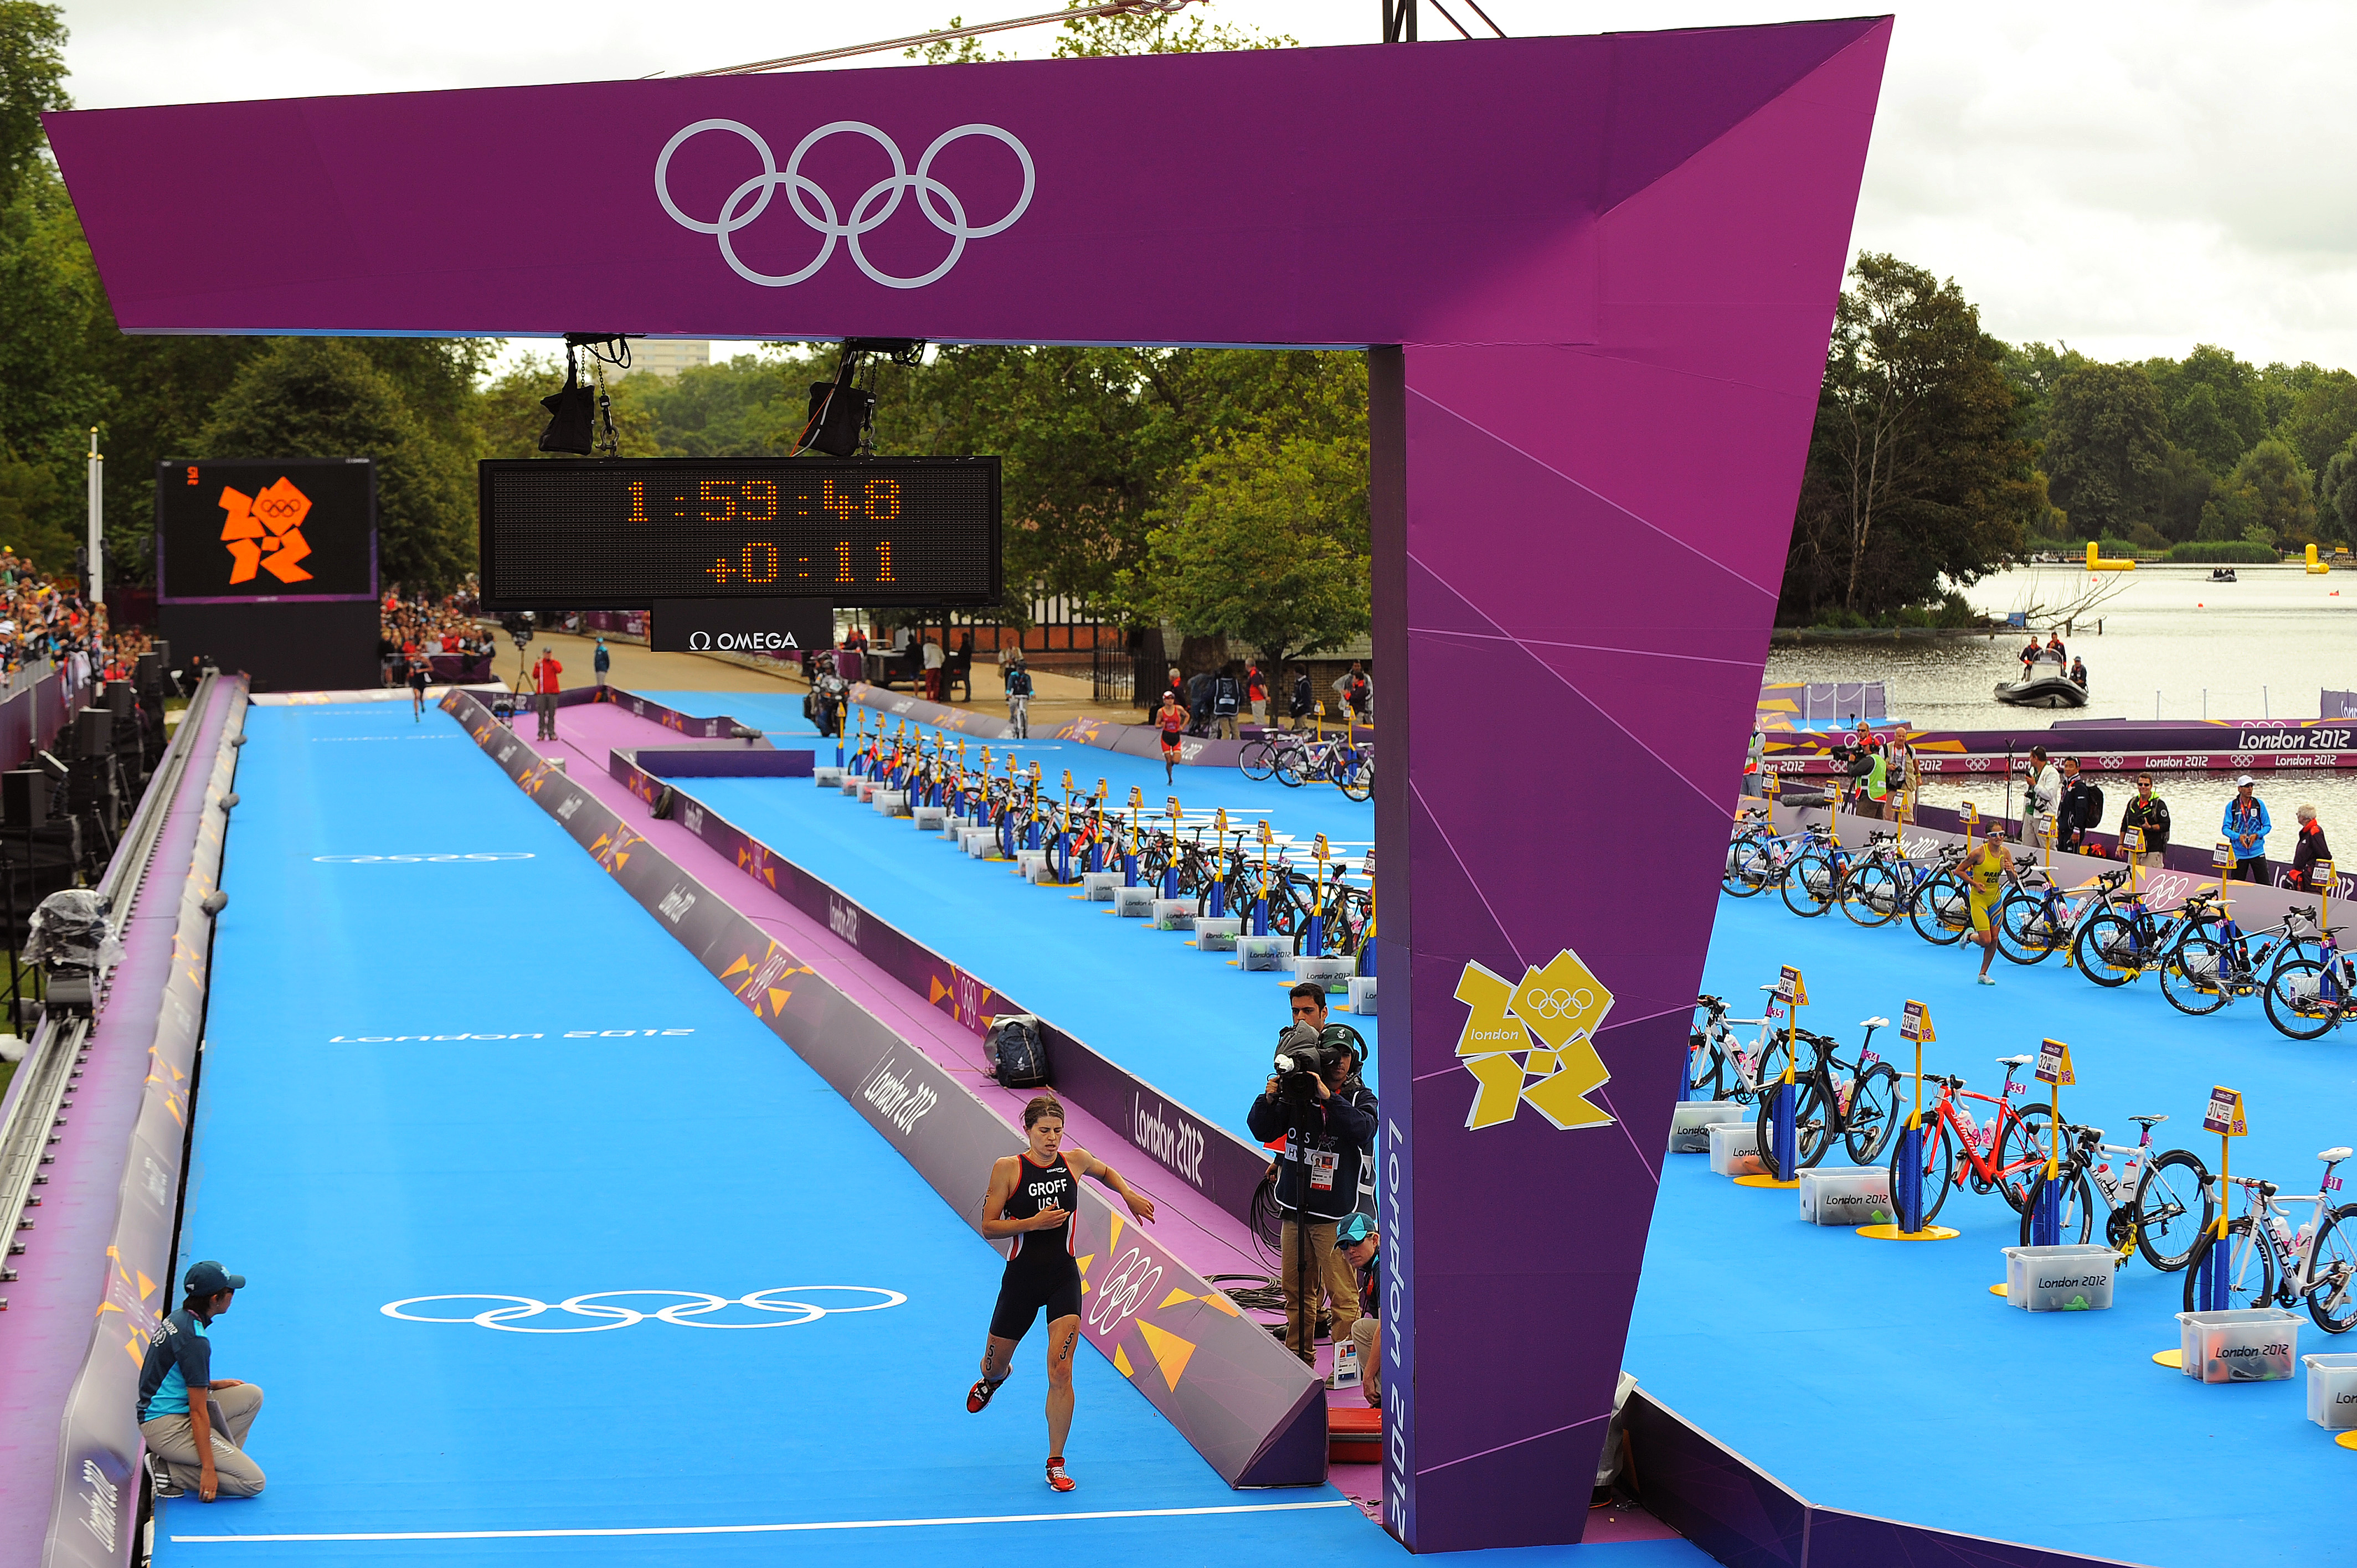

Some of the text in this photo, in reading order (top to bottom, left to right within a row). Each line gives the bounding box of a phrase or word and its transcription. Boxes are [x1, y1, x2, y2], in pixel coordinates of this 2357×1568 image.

[628, 479, 900, 522] 1:59:48
[706, 541, 896, 583] +0:11
[717, 631, 798, 649] OMEGA
[2238, 729, 2350, 750] London 2012
[1780, 761, 1805, 772] 2012
[1918, 760, 1942, 771] 2012
[2145, 756, 2208, 767] London 2012
[2276, 754, 2337, 766] London 2012
[1771, 1008, 1782, 1018] 35
[1902, 1014, 1910, 1029] 33
[330, 1029, 695, 1043] London 2012
[1470, 1028, 1519, 1041] london
[1866, 1052, 1877, 1062] 34
[2038, 1054, 2047, 1070] 32
[2010, 1081, 2024, 1094] 33
[864, 1058, 938, 1136] London 2012
[2207, 1101, 2217, 1117] 31
[1135, 1091, 1204, 1188] London 2012
[1288, 1127, 1310, 1144] OS
[1733, 1147, 1761, 1156] Londo
[1028, 1178, 1067, 1196] GROFF
[2328, 1176, 2339, 1189] 31
[1038, 1196, 1060, 1211] USA
[1826, 1194, 1888, 1205] London 2012
[2263, 1217, 2295, 1279] FOCUS
[2039, 1276, 2107, 1288] London 2012
[1389, 1117, 1406, 1542] London 2012
[1060, 1332, 1074, 1360] 53
[2216, 1344, 2289, 1358] London 2012
[985, 1344, 995, 1371] 53
[2336, 1392, 2357, 1404] Lon
